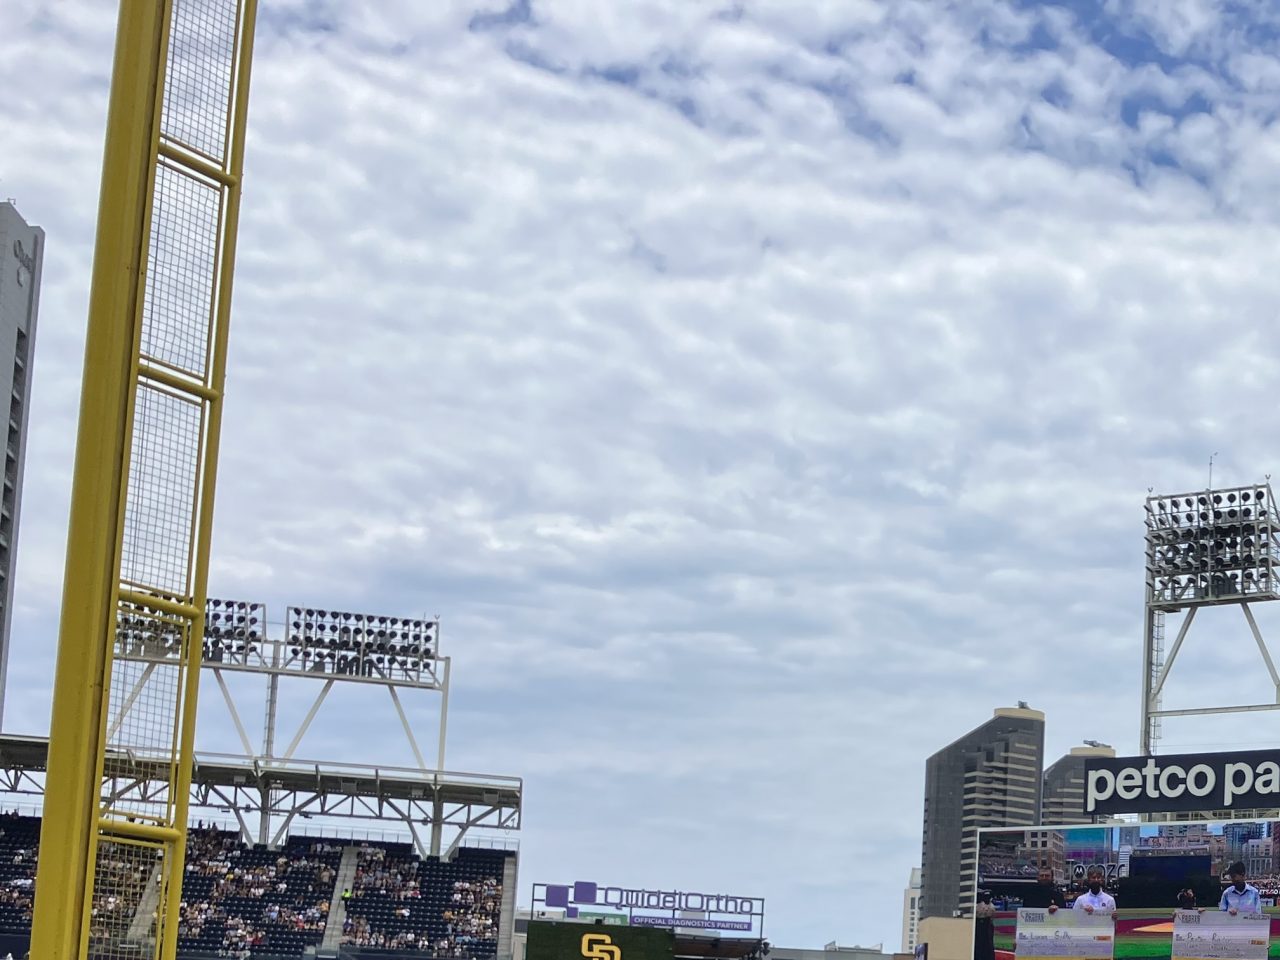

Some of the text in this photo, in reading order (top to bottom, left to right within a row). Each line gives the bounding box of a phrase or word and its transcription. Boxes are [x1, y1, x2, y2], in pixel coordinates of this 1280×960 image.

[1087, 758, 1217, 812] petco
[604, 887, 753, 914] QuidelOrtho
[634, 916, 749, 930] OFFICIAL DIAGNOSTICS PARTNER
